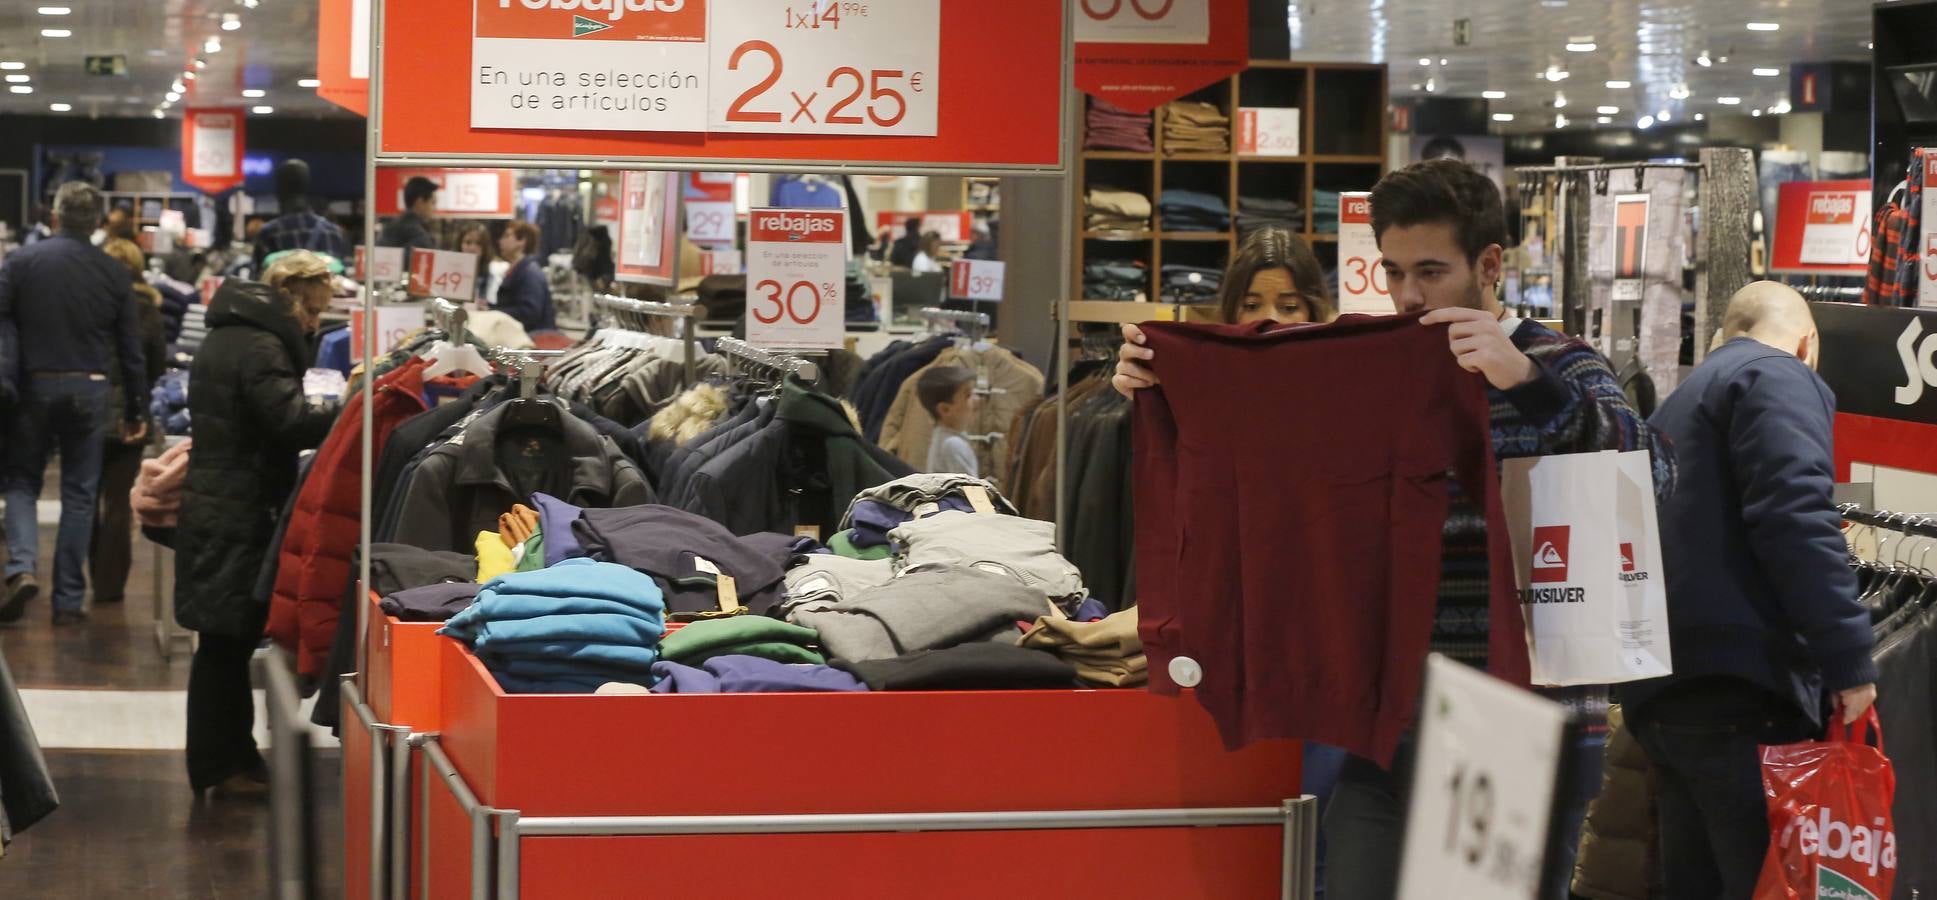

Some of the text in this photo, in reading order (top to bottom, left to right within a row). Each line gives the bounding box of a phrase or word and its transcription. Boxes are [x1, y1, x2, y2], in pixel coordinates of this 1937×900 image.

[480, 66, 699, 89] En una selección
[510, 91, 668, 112] de artículos
[759, 213, 835, 235] rebajas
[434, 272, 462, 292] 49
